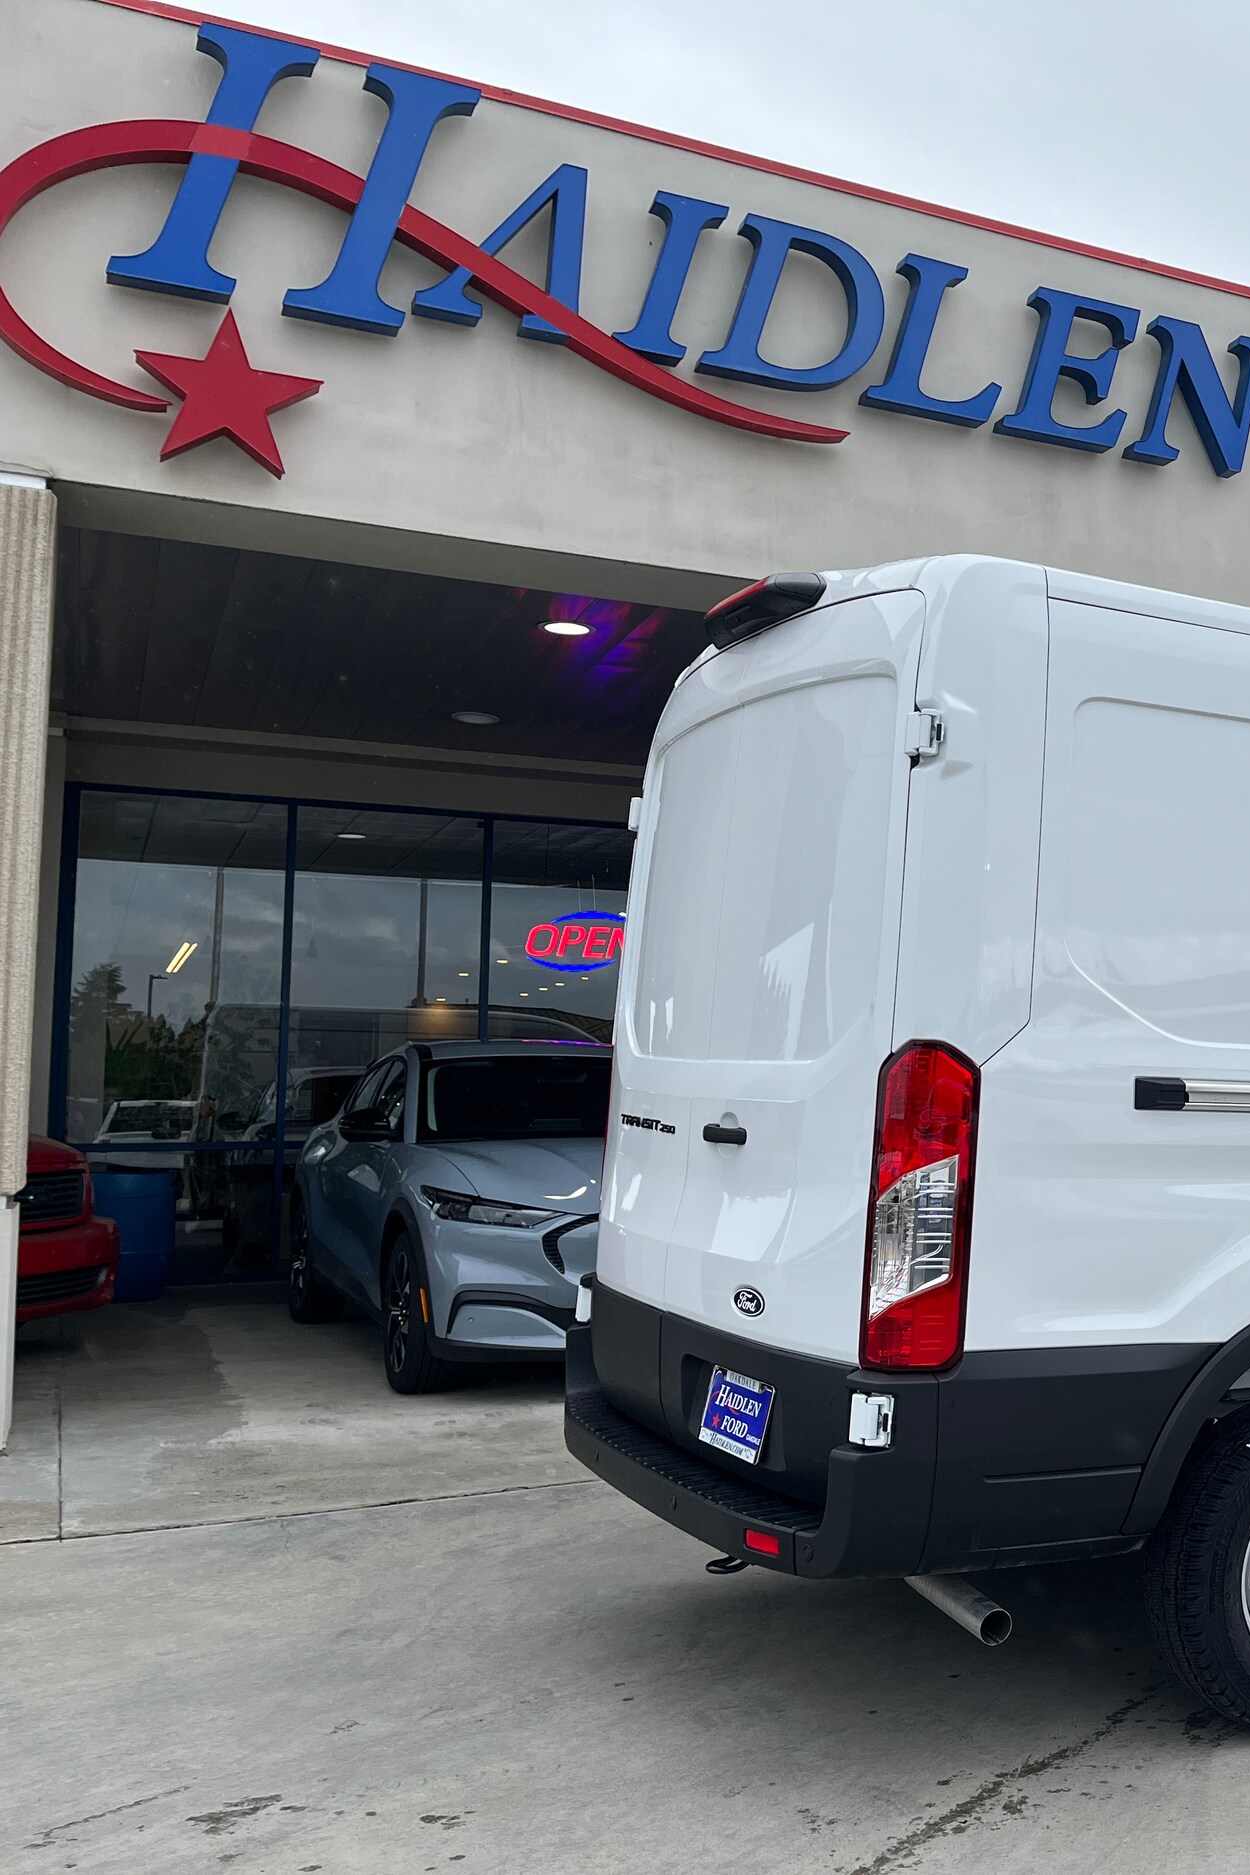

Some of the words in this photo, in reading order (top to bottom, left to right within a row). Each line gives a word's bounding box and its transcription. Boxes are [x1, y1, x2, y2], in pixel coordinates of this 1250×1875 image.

[620, 1113, 661, 1131] TRANSIT
[659, 1123, 676, 1135] 250
[736, 1291, 758, 1312] Ford
[729, 1372, 757, 1390] OAKDALE
[714, 1383, 763, 1418] HAIDLEN
[720, 1415, 749, 1438] FORD
